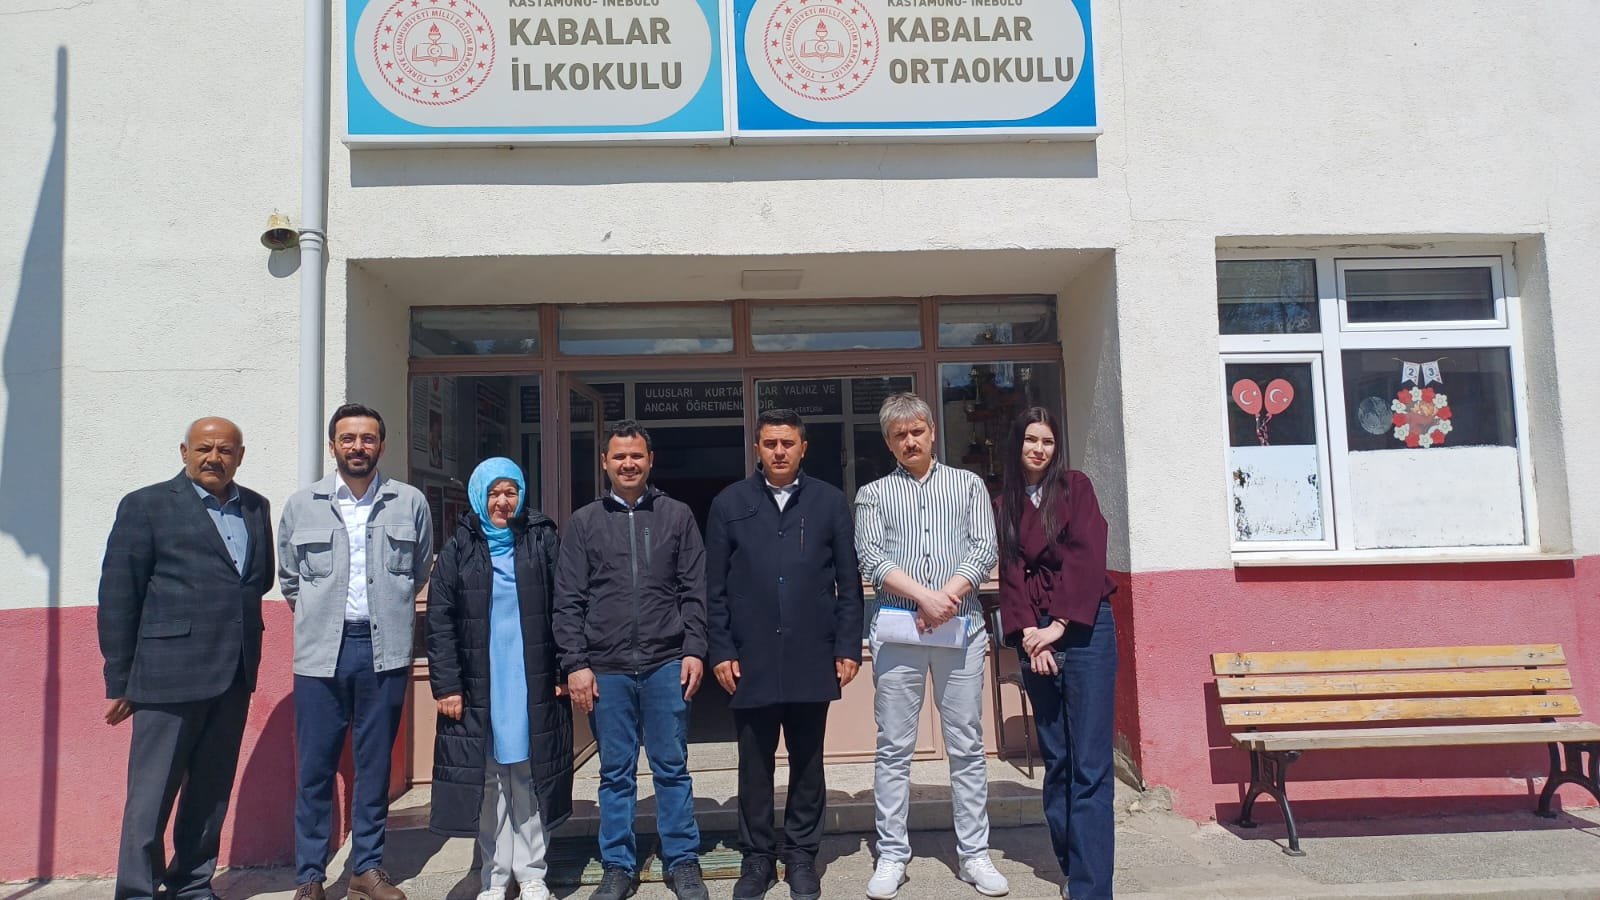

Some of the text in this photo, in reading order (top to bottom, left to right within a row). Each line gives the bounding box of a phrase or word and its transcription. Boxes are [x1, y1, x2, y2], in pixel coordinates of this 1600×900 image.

[508, 18, 671, 46] KABALAR
[887, 17, 1033, 42] KABALAR
[511, 57, 683, 91] İLKOKULU
[888, 57, 1074, 84] ORTAOKULU
[1408, 368, 1435, 376] 2 3
[645, 387, 693, 398] ULUSLARI
[784, 384, 818, 396] YALNIZ
[823, 384, 836, 395] VE
[644, 402, 679, 413] ANCAK
